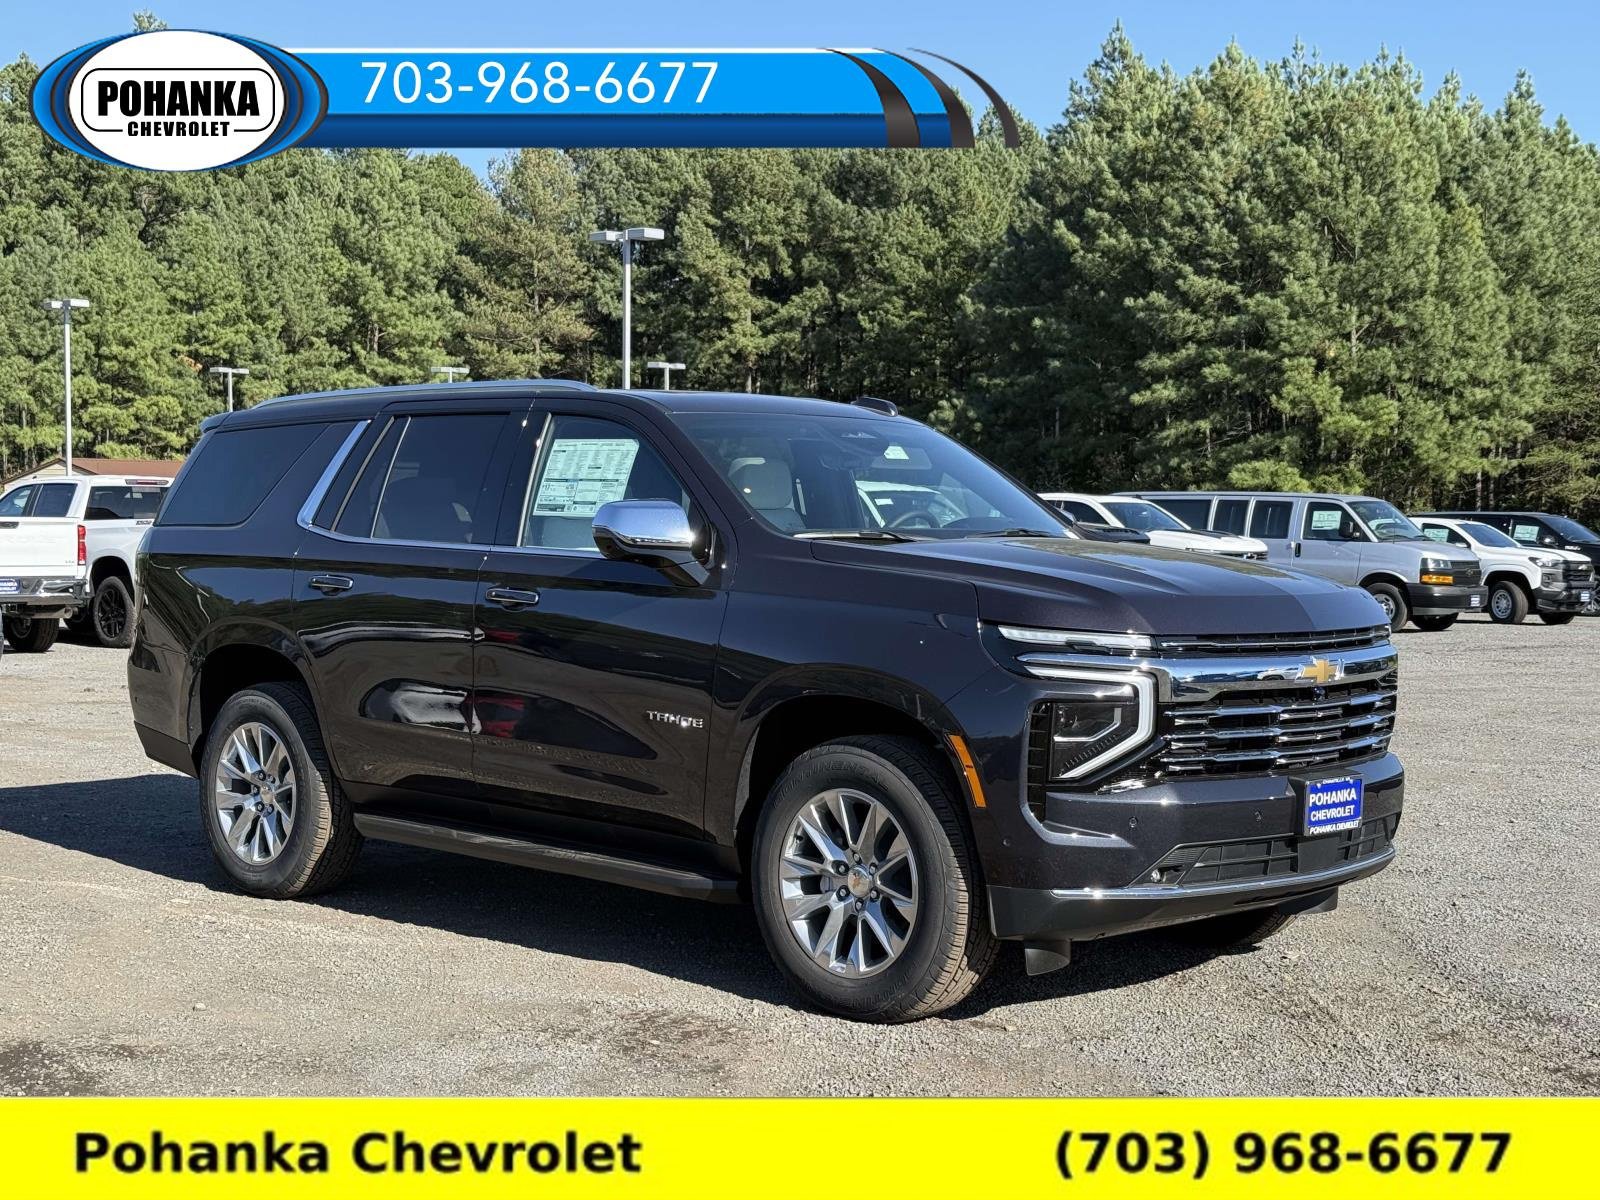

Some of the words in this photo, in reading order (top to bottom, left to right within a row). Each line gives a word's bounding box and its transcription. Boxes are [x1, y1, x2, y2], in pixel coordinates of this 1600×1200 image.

[646, 710, 704, 728] TAHOE
[1309, 788, 1357, 807] POHANKA
[1310, 805, 1355, 822] CHEVROLET
[1309, 823, 1336, 835] POHANKA
[1336, 820, 1360, 831] CHEVROLET
